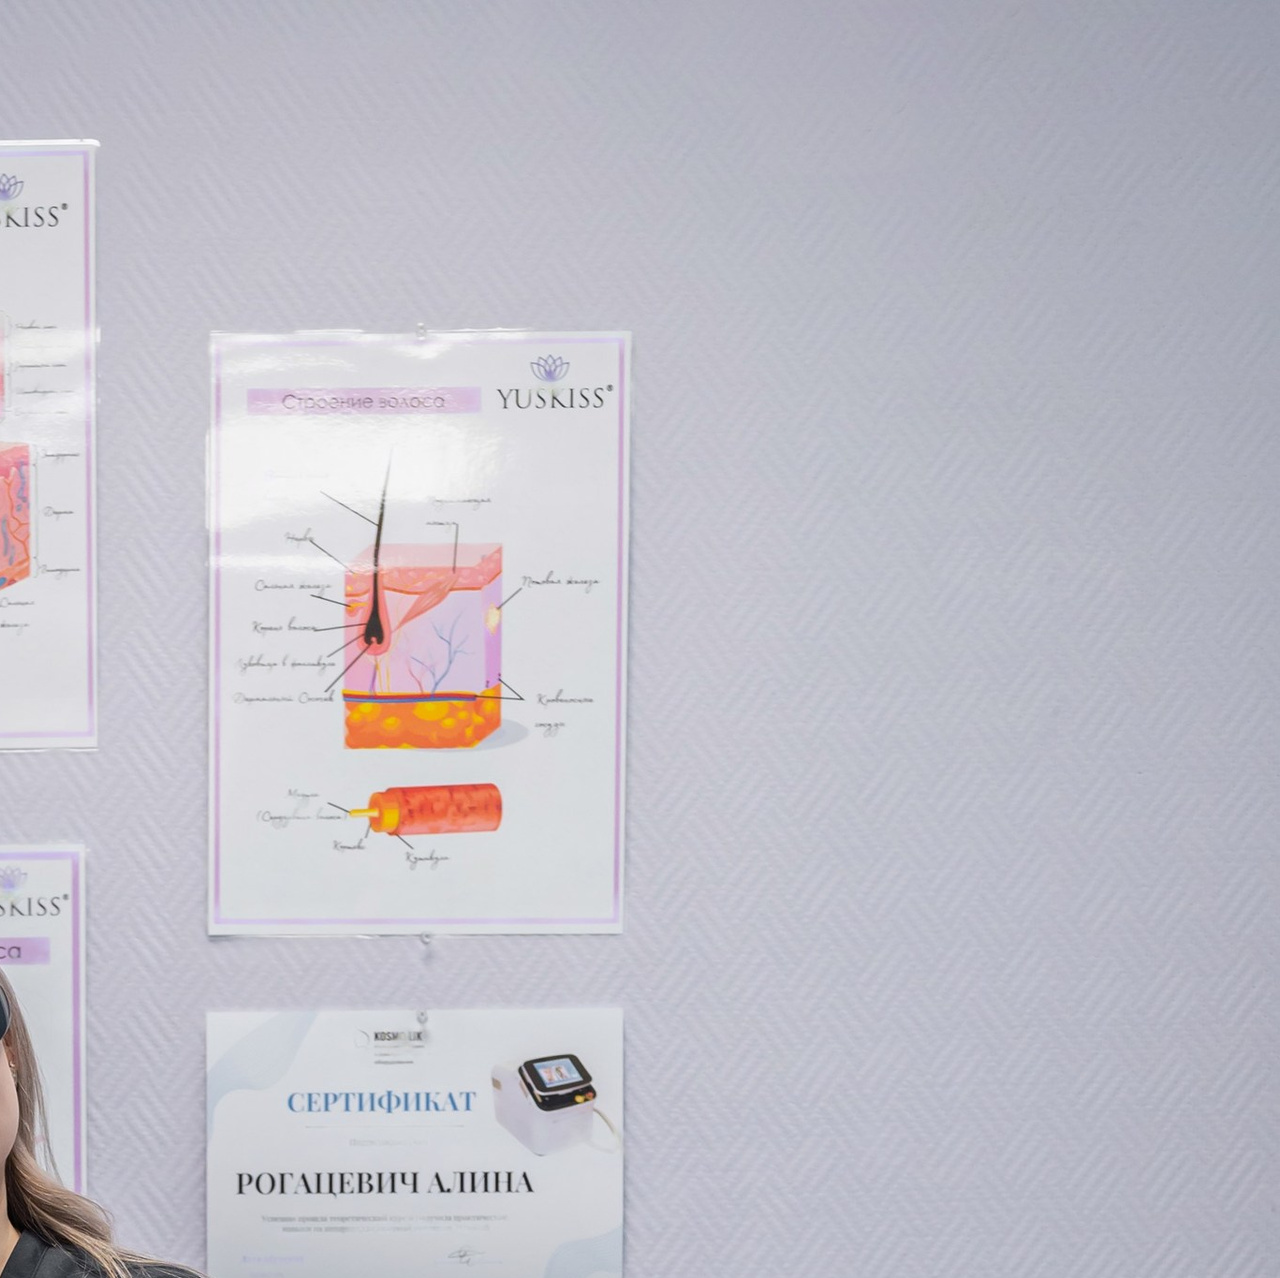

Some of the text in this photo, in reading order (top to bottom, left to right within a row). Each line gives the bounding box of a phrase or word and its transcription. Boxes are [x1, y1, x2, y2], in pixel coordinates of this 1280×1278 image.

[282, 393, 446, 411] Строение волоса
[287, 1090, 477, 1114] СЕРТИФИКАТ
[236, 1171, 535, 1199] РОГАЦЕВИЧ АЛИНА
